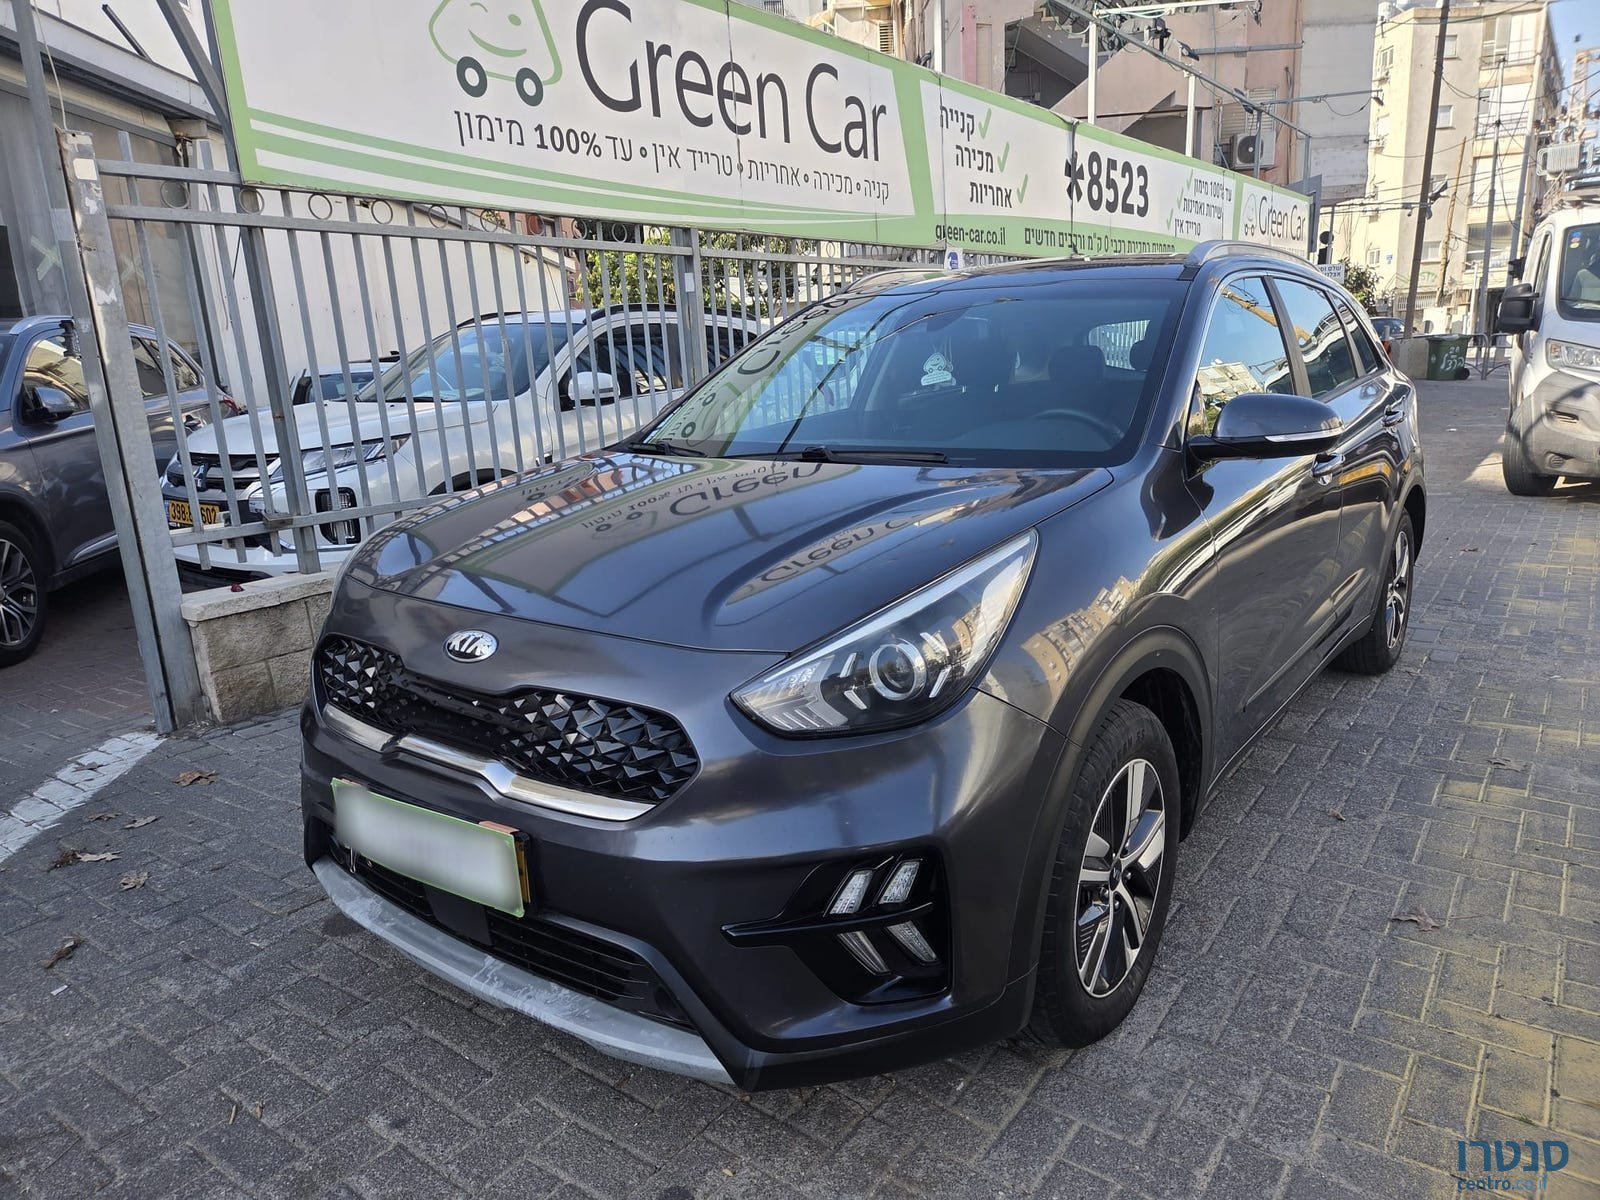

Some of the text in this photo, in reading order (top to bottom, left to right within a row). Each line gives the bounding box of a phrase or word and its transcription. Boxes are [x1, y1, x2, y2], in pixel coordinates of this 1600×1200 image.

[575, 0, 887, 162] Green Car
[454, 110, 889, 205] קניה מכירה אחריות טרייד אין עד 100% מימון
[955, 144, 994, 173] מכירה
[970, 181, 1013, 209] אחריות
[1194, 178, 1208, 197] מימון
[1174, 218, 1184, 238] אין
[1259, 195, 1306, 242] Green Car
[935, 224, 1006, 246] green-car.co.il
[1024, 227, 1056, 247] חדשים
[448, 631, 491, 657] KIA
